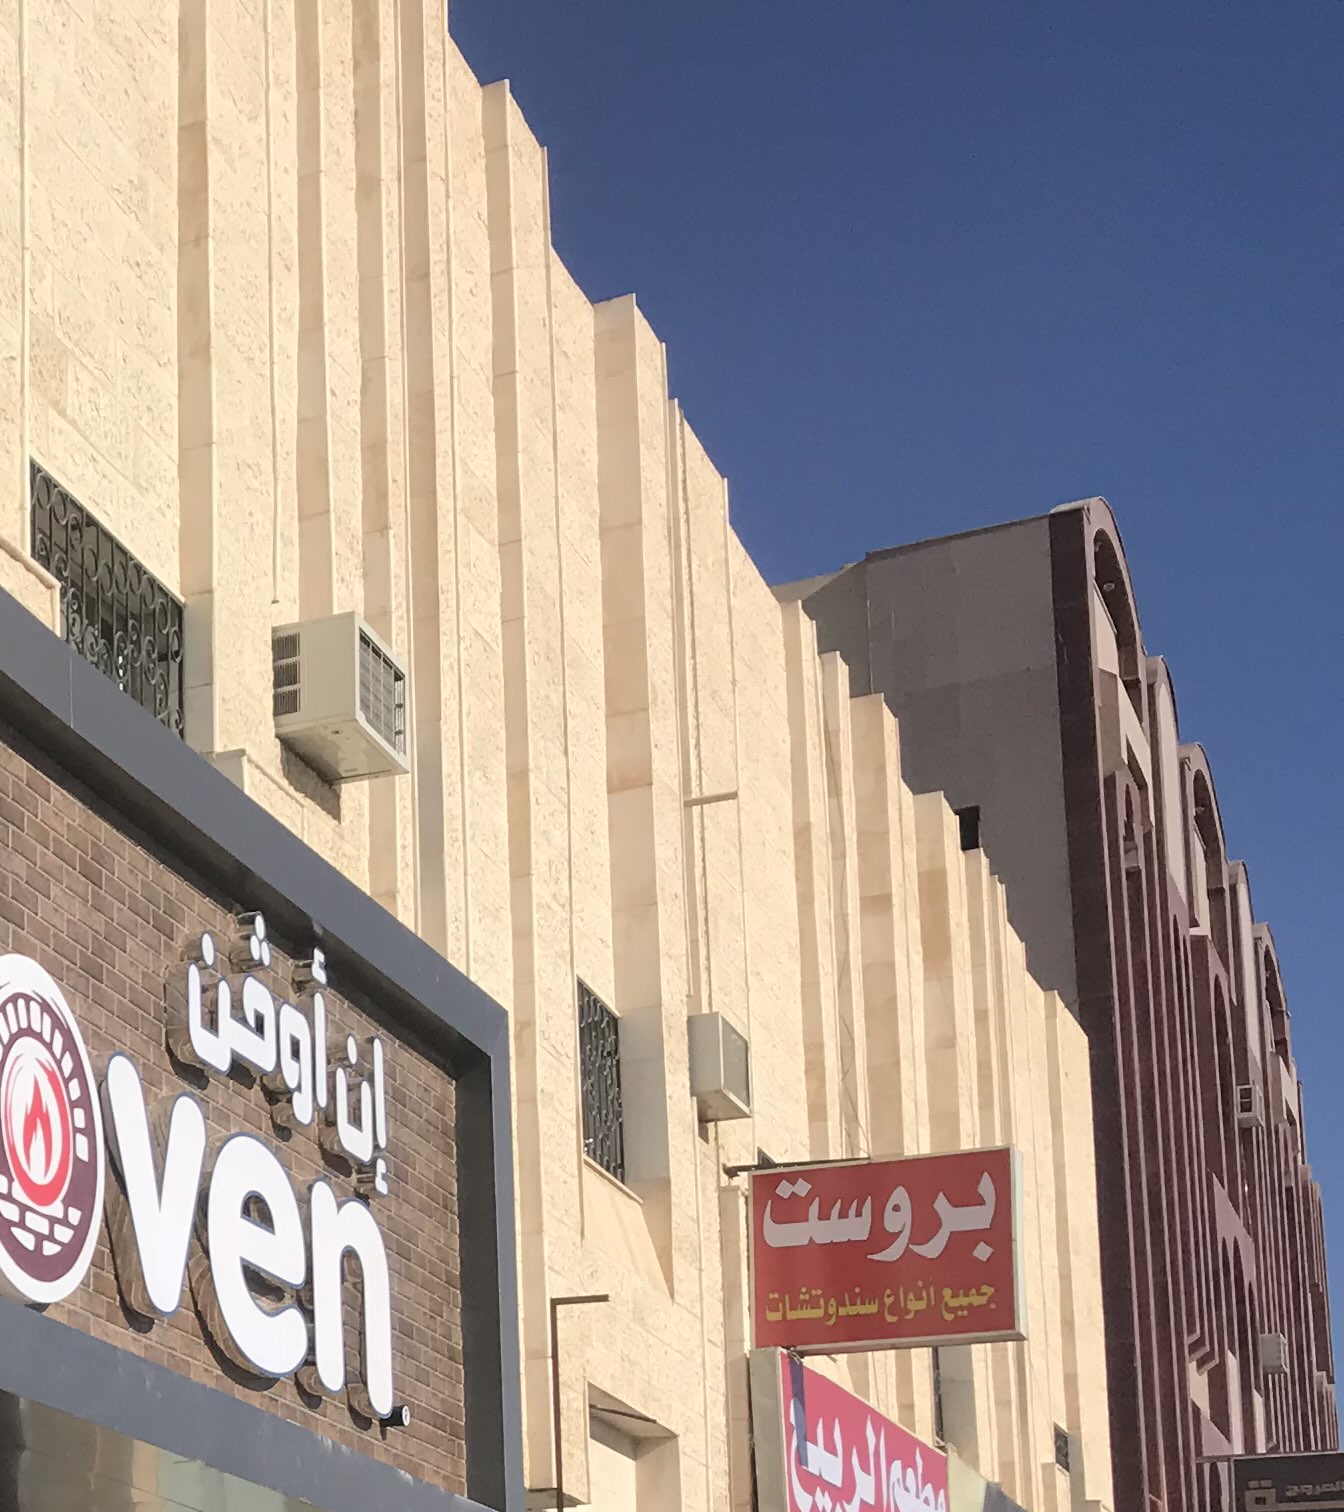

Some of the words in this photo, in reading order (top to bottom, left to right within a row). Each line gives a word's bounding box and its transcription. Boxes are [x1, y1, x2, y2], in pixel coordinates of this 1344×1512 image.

[763, 1171, 996, 1262] بروست
[766, 1286, 879, 1326] سندوتشات
[941, 1283, 997, 1321] جميع
